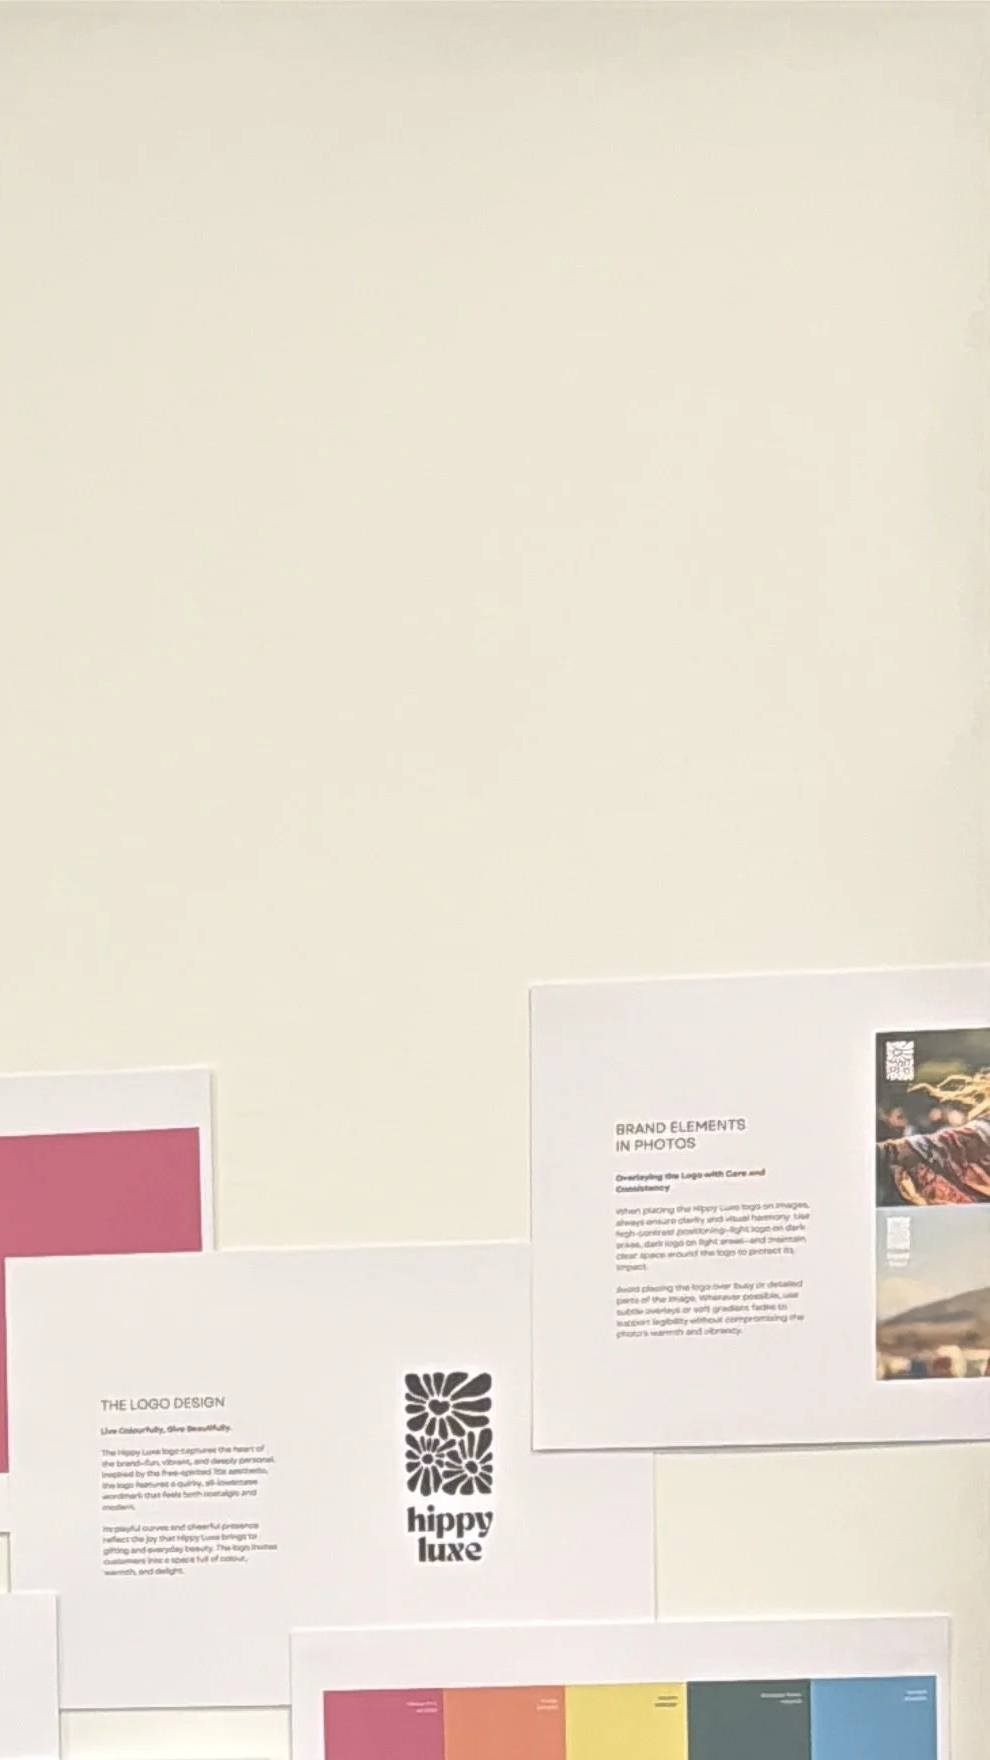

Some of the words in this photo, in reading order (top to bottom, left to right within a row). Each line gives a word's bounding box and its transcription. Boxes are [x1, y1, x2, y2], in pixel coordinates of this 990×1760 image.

[616, 1121, 666, 1135] BRAND
[671, 1118, 746, 1133] ELEMENTS
[616, 1139, 630, 1152] IN
[635, 1136, 696, 1151] PHOTOS
[664, 1171, 679, 1179] the
[680, 1170, 702, 1180] Logo
[725, 1169, 747, 1177] Care
[748, 1168, 765, 1176] and
[101, 1398, 126, 1411] THE
[130, 1397, 170, 1410] LOGO
[174, 1396, 225, 1409] DESIGN
[407, 1506, 493, 1538] hippy
[418, 1538, 481, 1562] luxe
